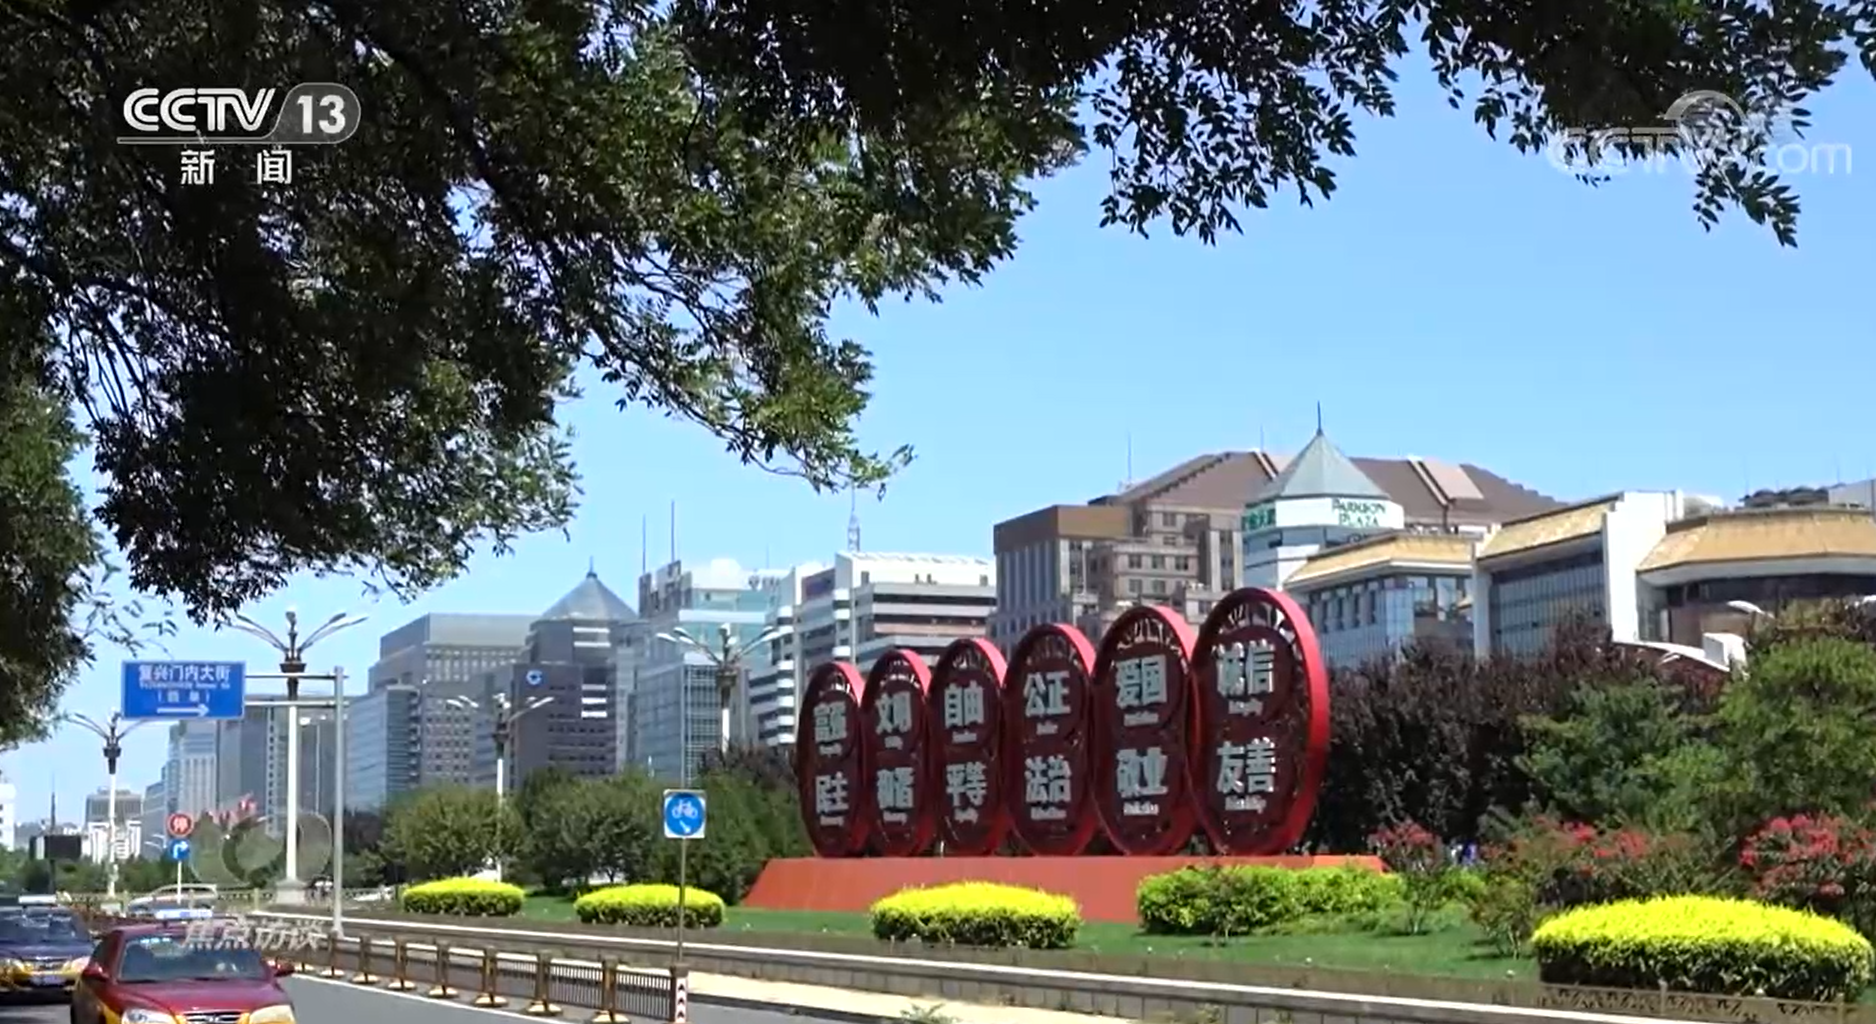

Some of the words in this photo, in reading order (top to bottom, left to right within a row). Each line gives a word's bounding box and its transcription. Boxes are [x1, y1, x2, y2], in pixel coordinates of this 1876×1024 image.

[1339, 513, 1380, 528] PLAZA
[139, 664, 231, 682] 复兴门内大街
[1023, 670, 1072, 717] 公正
[1115, 654, 1168, 709] 爱国
[944, 680, 984, 729] 自由
[946, 761, 987, 806] 平等
[1024, 754, 1072, 804] 法治
[1116, 746, 1169, 799] 敬业
[1216, 737, 1276, 795] 友善
[815, 771, 849, 814] 民主
